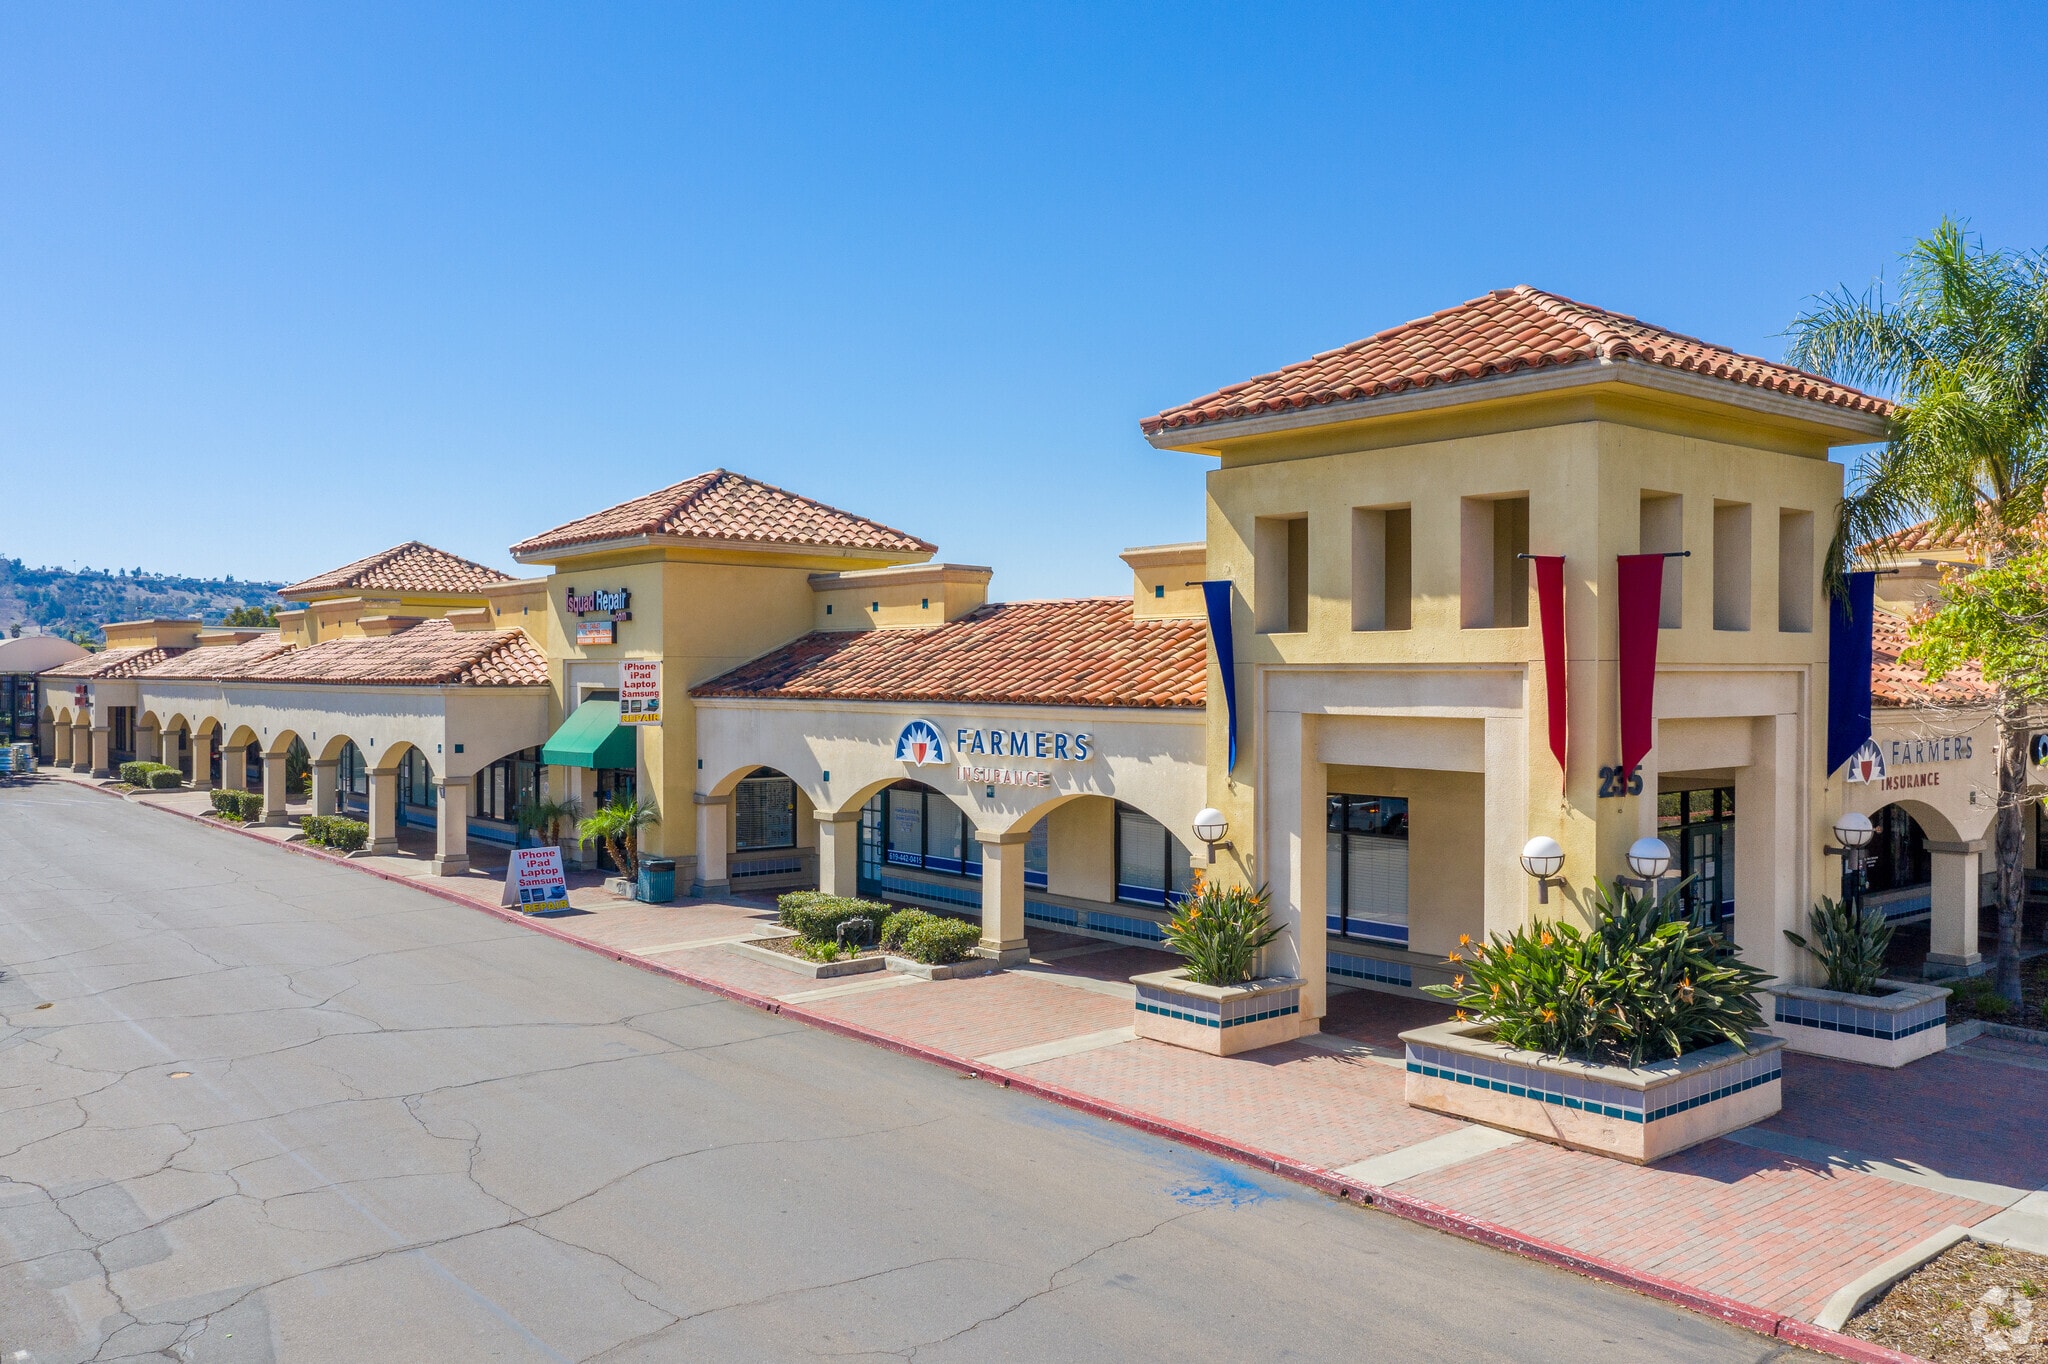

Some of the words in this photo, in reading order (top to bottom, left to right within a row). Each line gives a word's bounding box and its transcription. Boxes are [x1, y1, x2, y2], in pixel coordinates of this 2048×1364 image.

[596, 588, 627, 615] Repair
[624, 663, 656, 671] iPhone
[630, 671, 651, 679] iPad
[624, 681, 656, 689] Laptop
[621, 690, 660, 698] Samsung
[621, 713, 660, 723] REPAIR
[957, 729, 1090, 762] FARMERS
[1892, 736, 1973, 765] FARMERS
[957, 766, 1047, 788] INSURANCE
[1881, 772, 1940, 791] INSURANCE
[518, 850, 556, 860] iPhone
[526, 859, 551, 868] iPad
[520, 868, 559, 877] Laptop
[519, 876, 564, 887] Samsung
[523, 900, 569, 913] REPAIR
